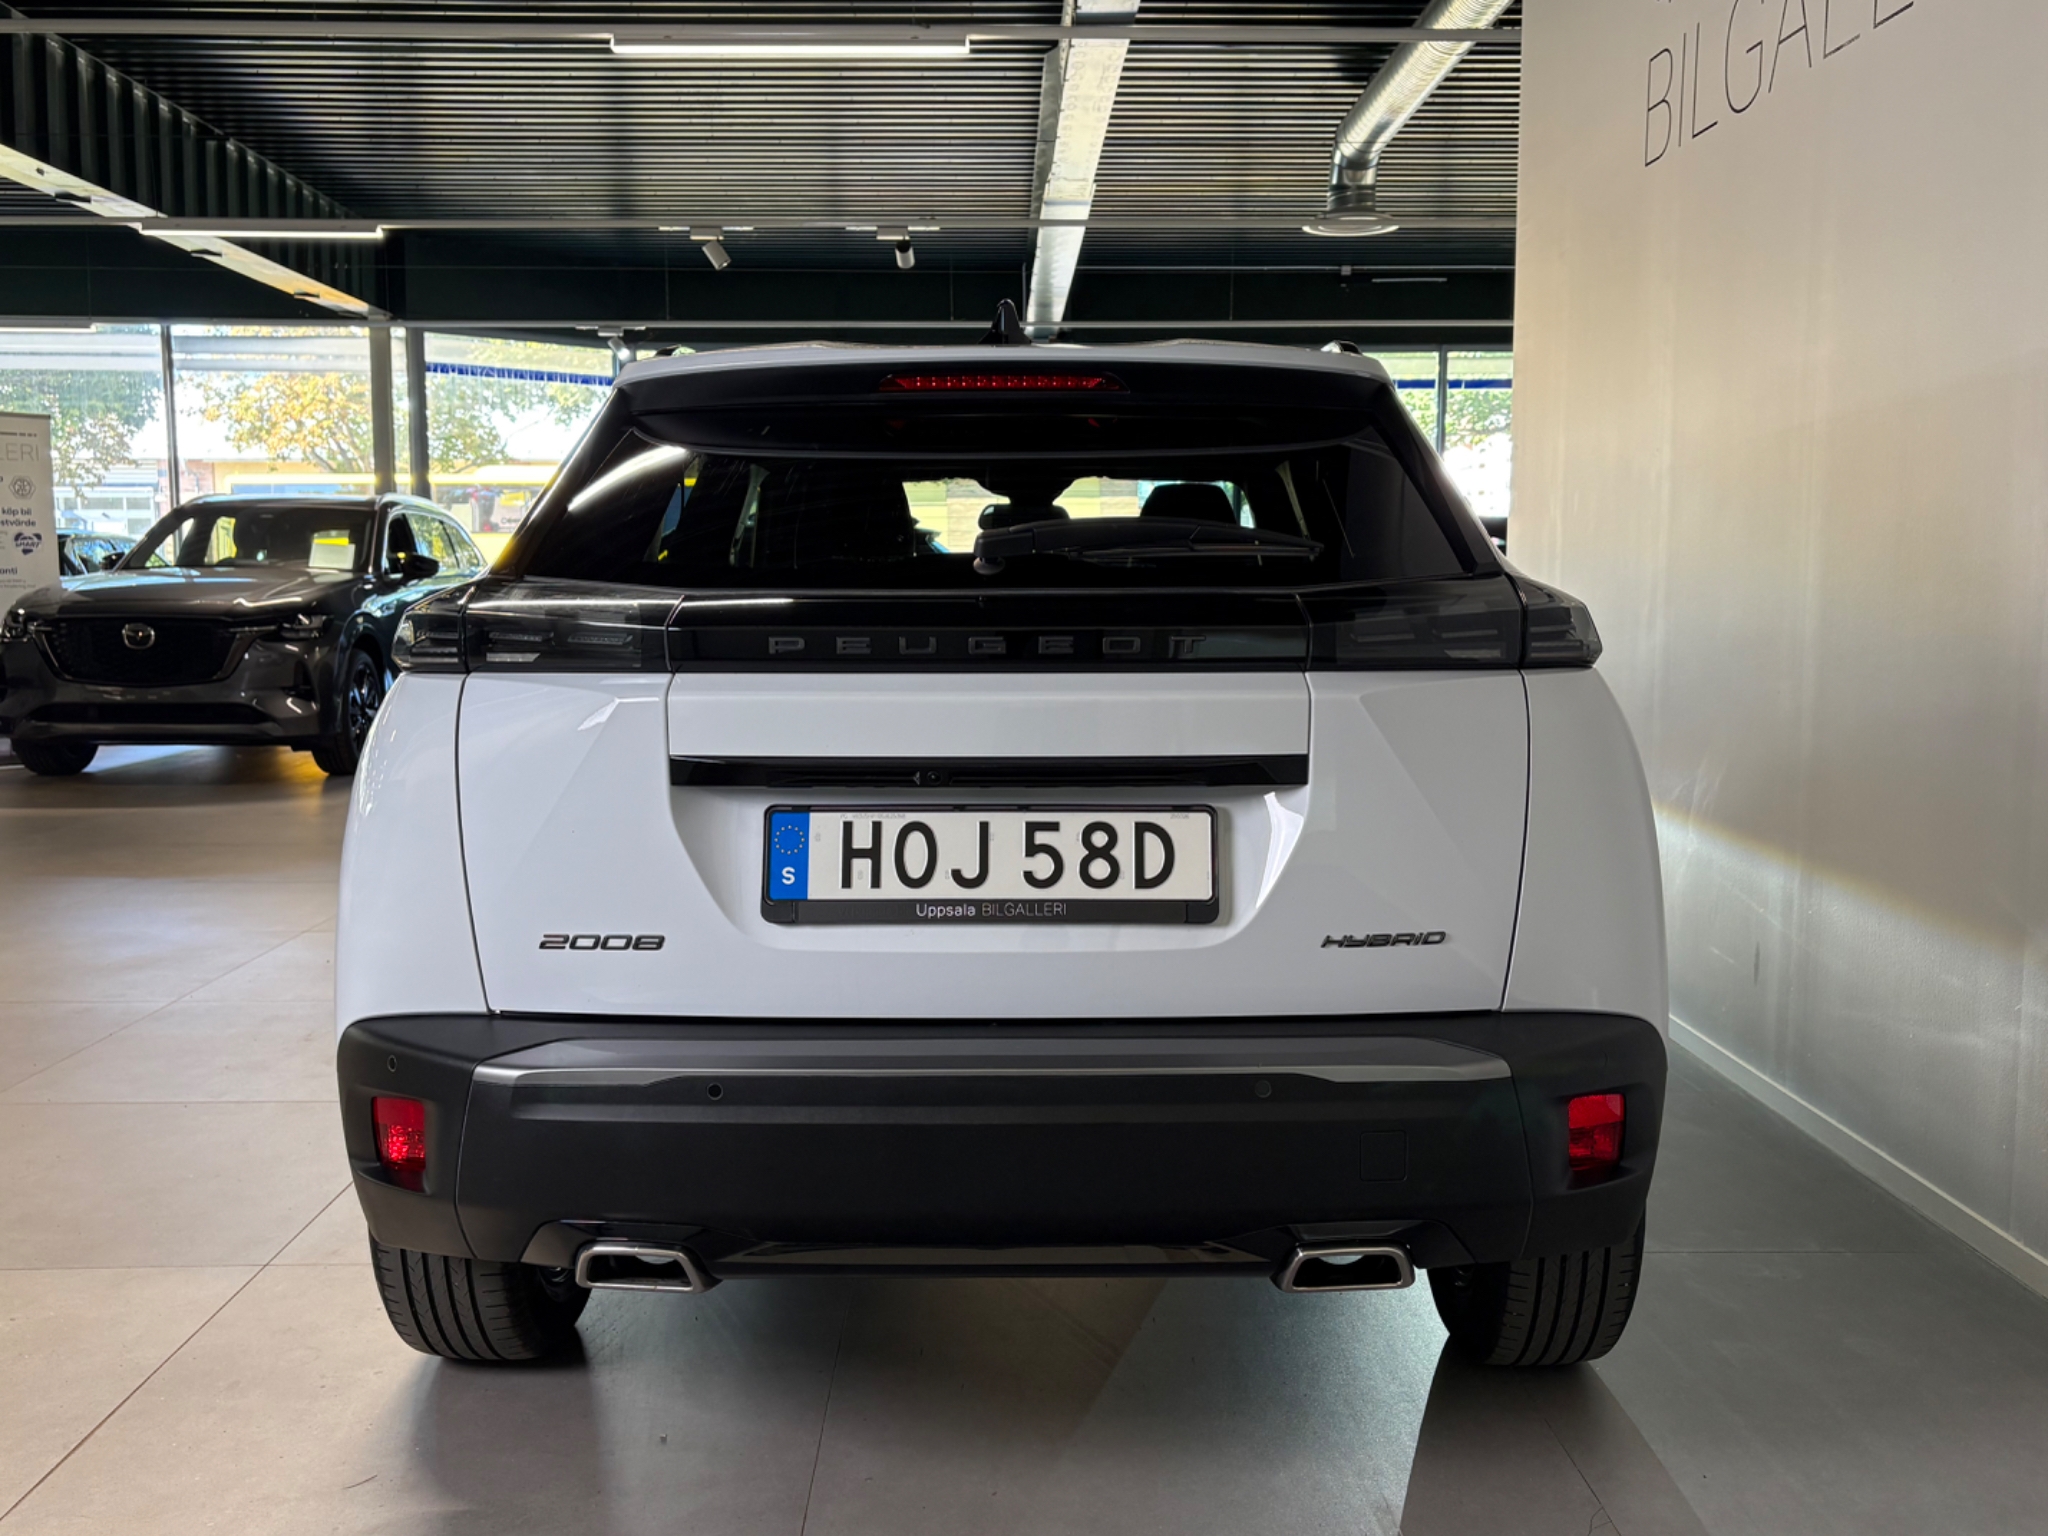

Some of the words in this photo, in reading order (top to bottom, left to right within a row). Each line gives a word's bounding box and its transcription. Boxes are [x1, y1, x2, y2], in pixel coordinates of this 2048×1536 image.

[768, 636, 1206, 655] PEUGEOT
[840, 820, 990, 890] HOJ
[1022, 820, 1176, 890] 58D
[782, 866, 796, 885] S
[915, 903, 976, 919] Uppsala
[981, 902, 1067, 916] BILGALLERI
[539, 934, 666, 950] 2008
[1320, 931, 1447, 948] HYBRID
